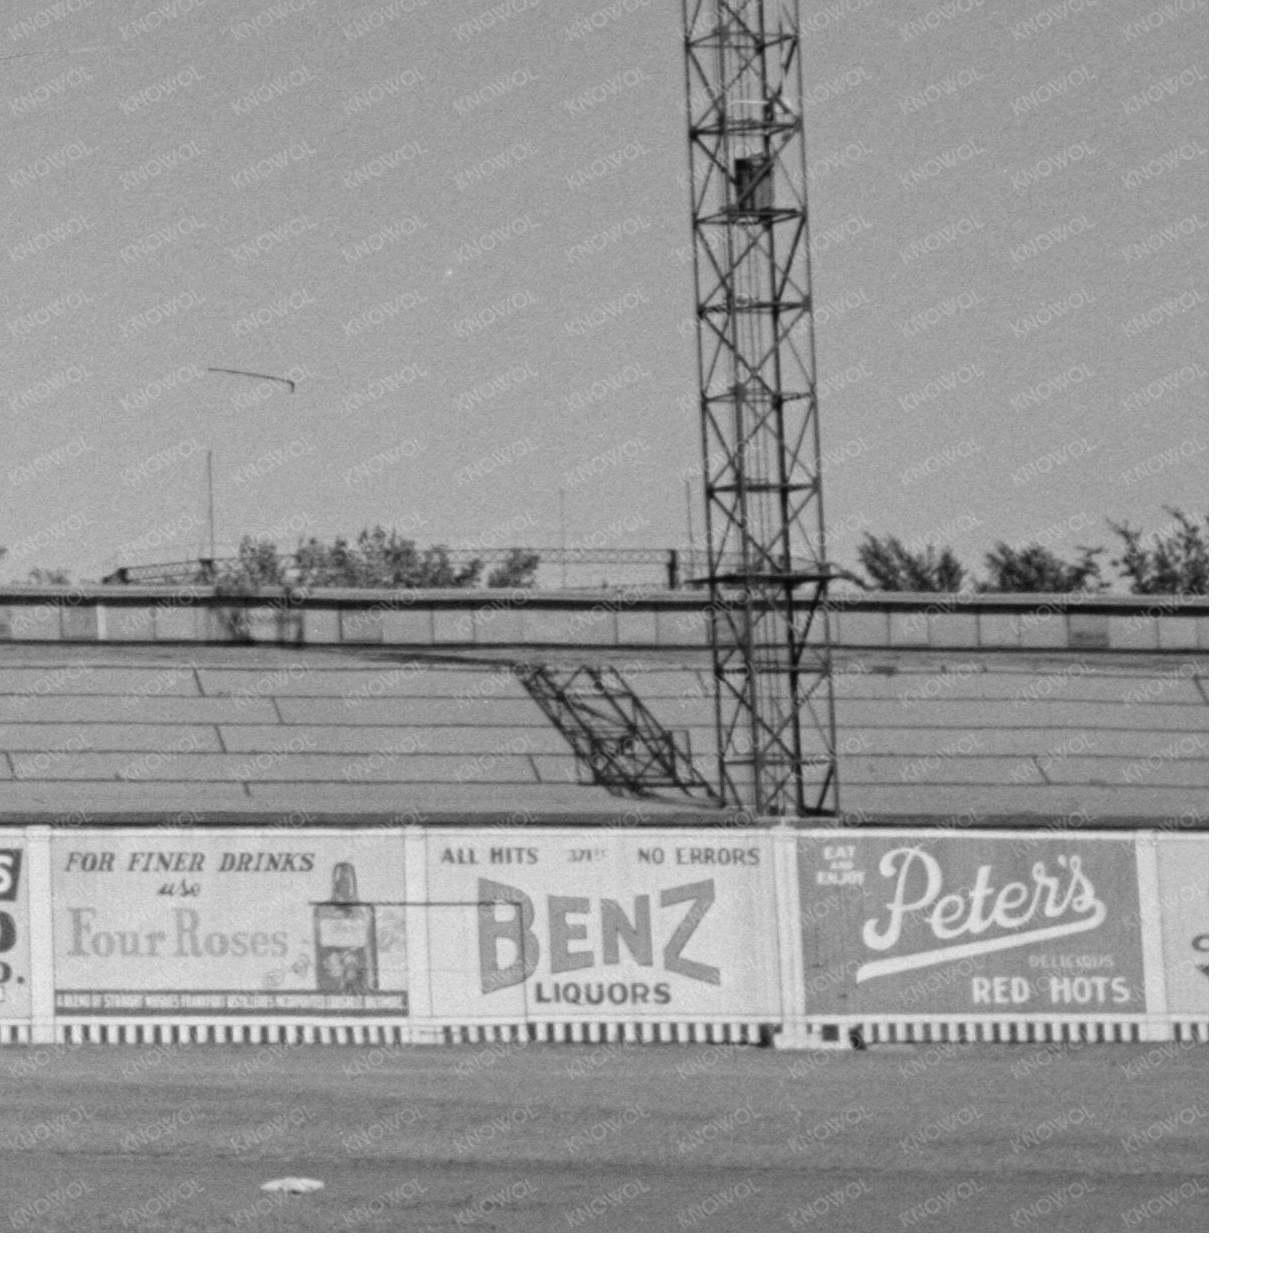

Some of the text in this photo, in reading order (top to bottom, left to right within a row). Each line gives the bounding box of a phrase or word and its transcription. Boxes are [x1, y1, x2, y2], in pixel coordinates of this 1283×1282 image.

[65, 852, 316, 872] FOR FINER DRINKS
[441, 847, 539, 865] ALL HITS
[638, 848, 761, 865] NO ERRORS
[823, 845, 856, 860] EAT
[156, 877, 201, 897] use
[816, 871, 865, 885] ENJOY
[862, 846, 1098, 950] Peter's
[67, 907, 288, 958] Four Roses
[478, 877, 721, 995] BENZ
[534, 981, 672, 1006] LIQUORS
[972, 976, 1131, 1004] RED HOTS
